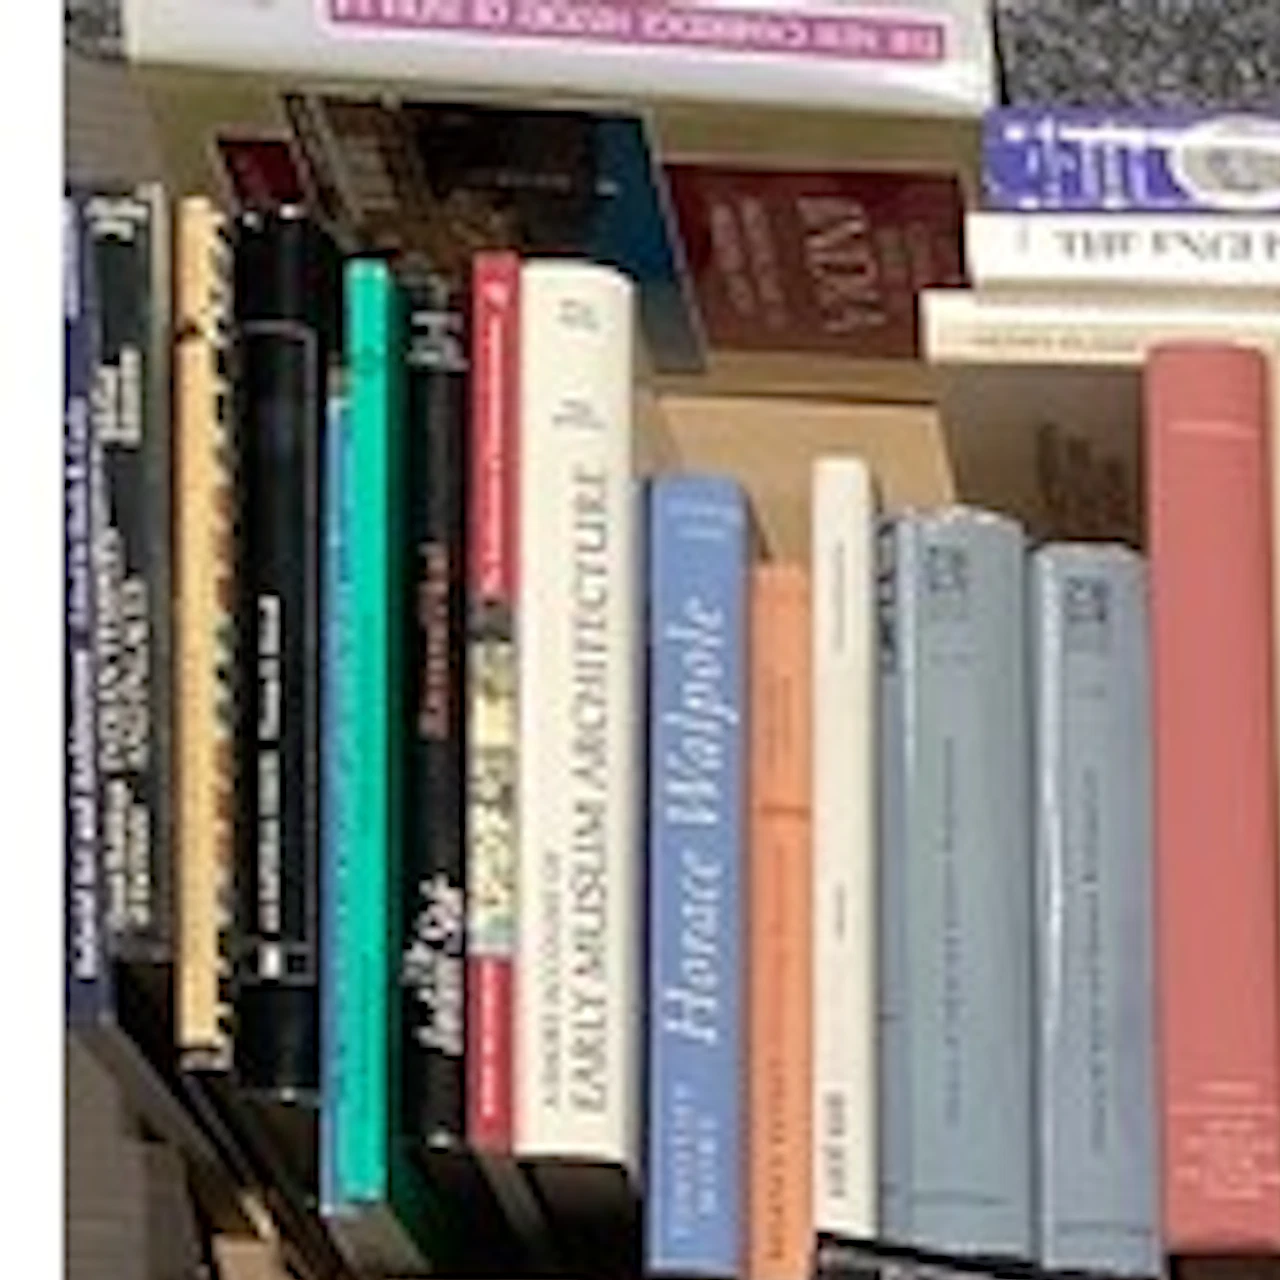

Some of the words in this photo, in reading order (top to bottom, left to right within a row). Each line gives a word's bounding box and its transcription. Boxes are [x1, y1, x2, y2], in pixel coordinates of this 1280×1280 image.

[1054, 229, 1132, 259] THE
[569, 463, 607, 791] ARCHITECTURE
[664, 596, 739, 828] Walpole
[569, 803, 607, 977] MUSLIM
[664, 851, 724, 1046] Horace
[569, 988, 607, 1111] EARLY
